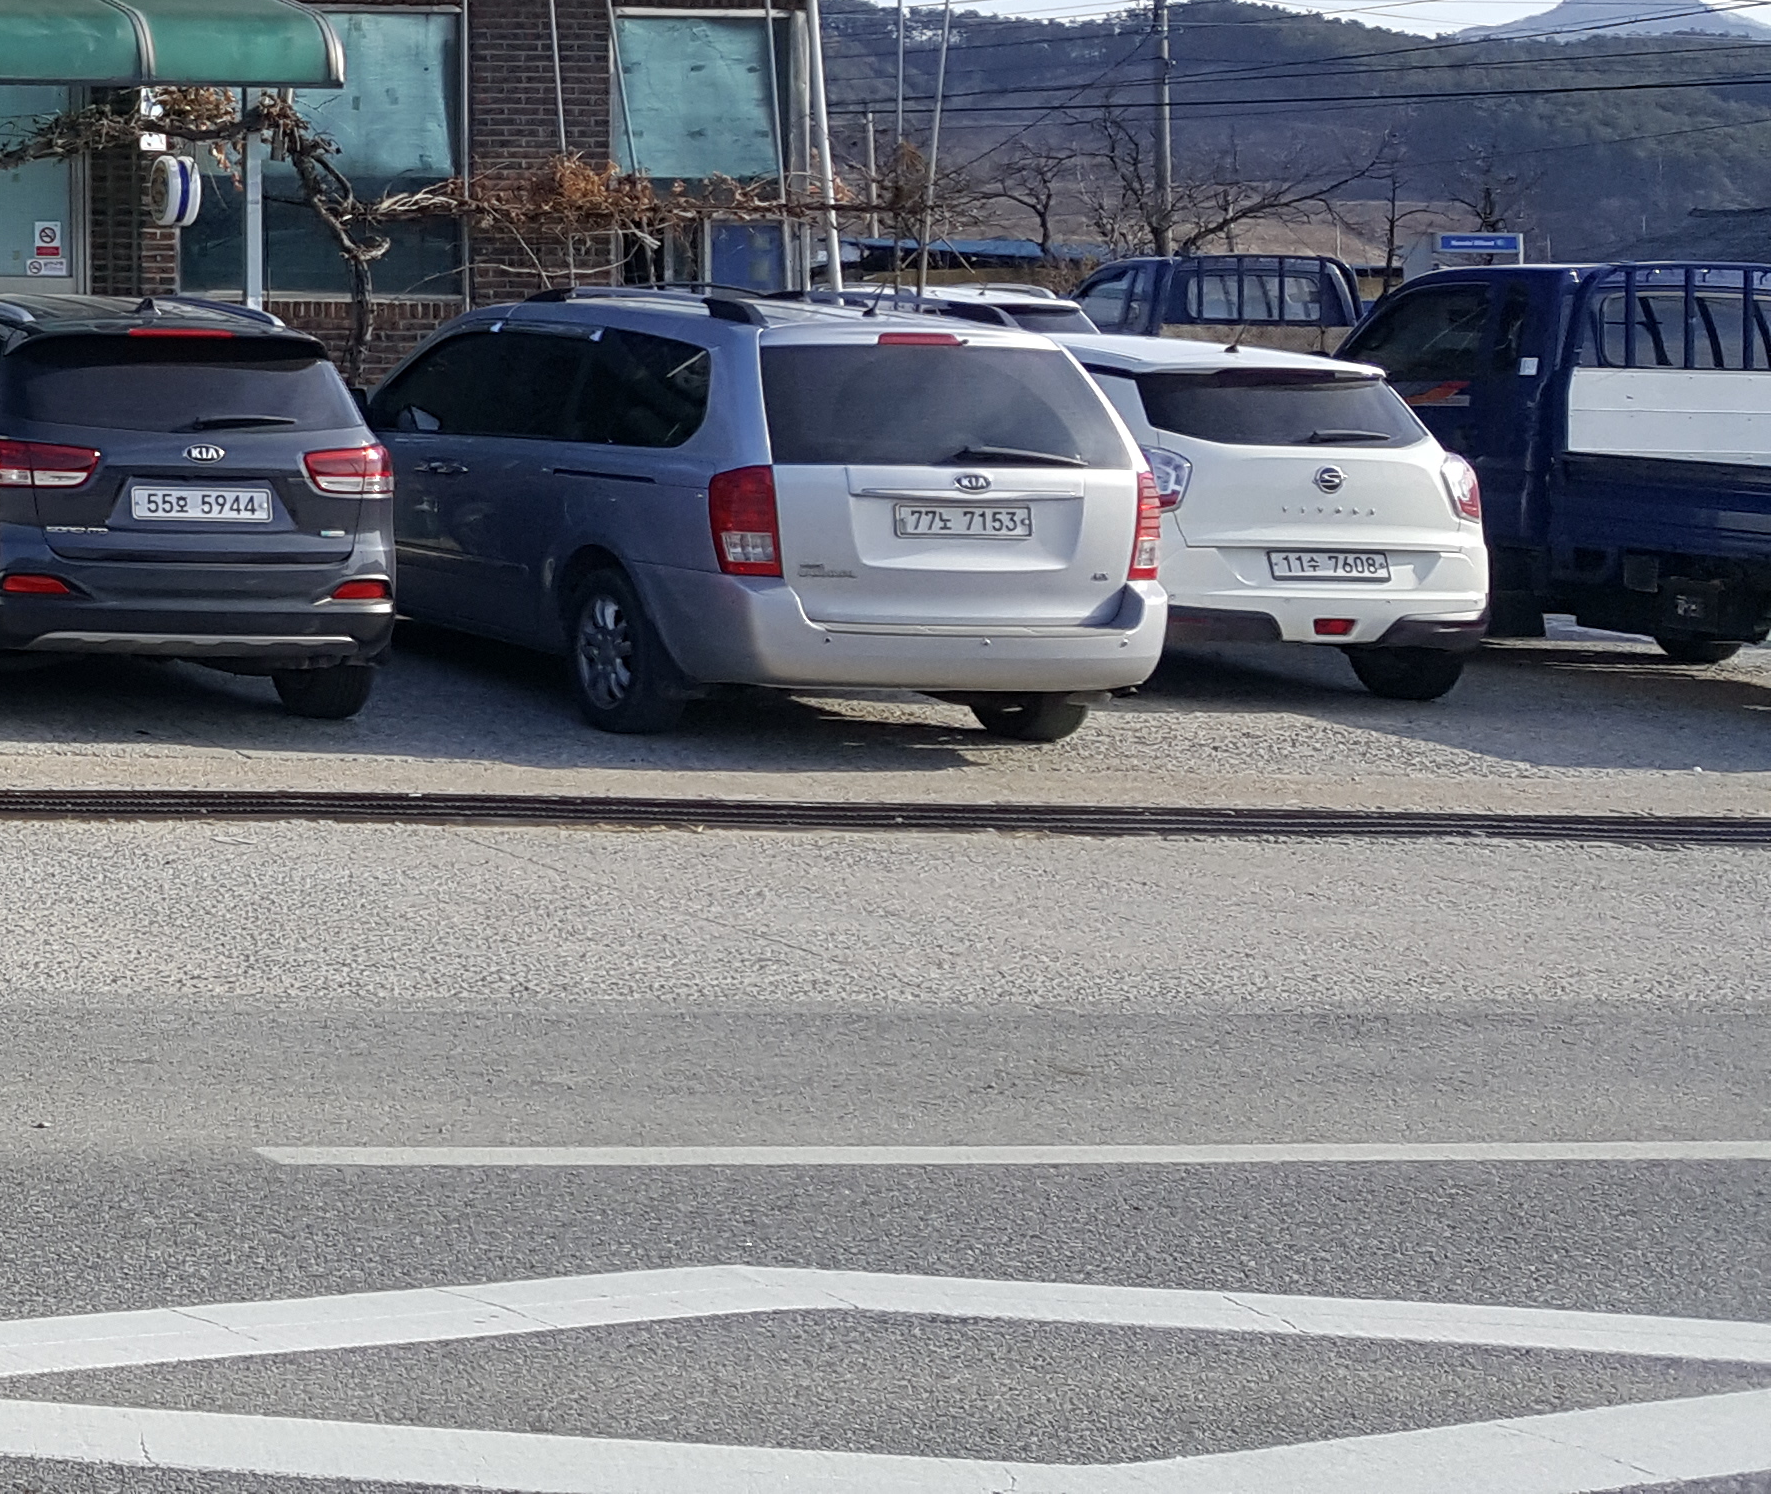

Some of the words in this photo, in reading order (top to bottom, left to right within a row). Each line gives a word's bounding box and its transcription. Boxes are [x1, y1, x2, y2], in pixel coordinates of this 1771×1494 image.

[191, 447, 217, 459] KIA
[959, 477, 988, 489] KIA
[147, 493, 189, 514] 55호
[201, 494, 257, 515] 5944
[910, 511, 952, 531] 77노
[963, 511, 1018, 532] 7153
[1282, 555, 1320, 573] 11수
[1328, 556, 1378, 574] 7608
